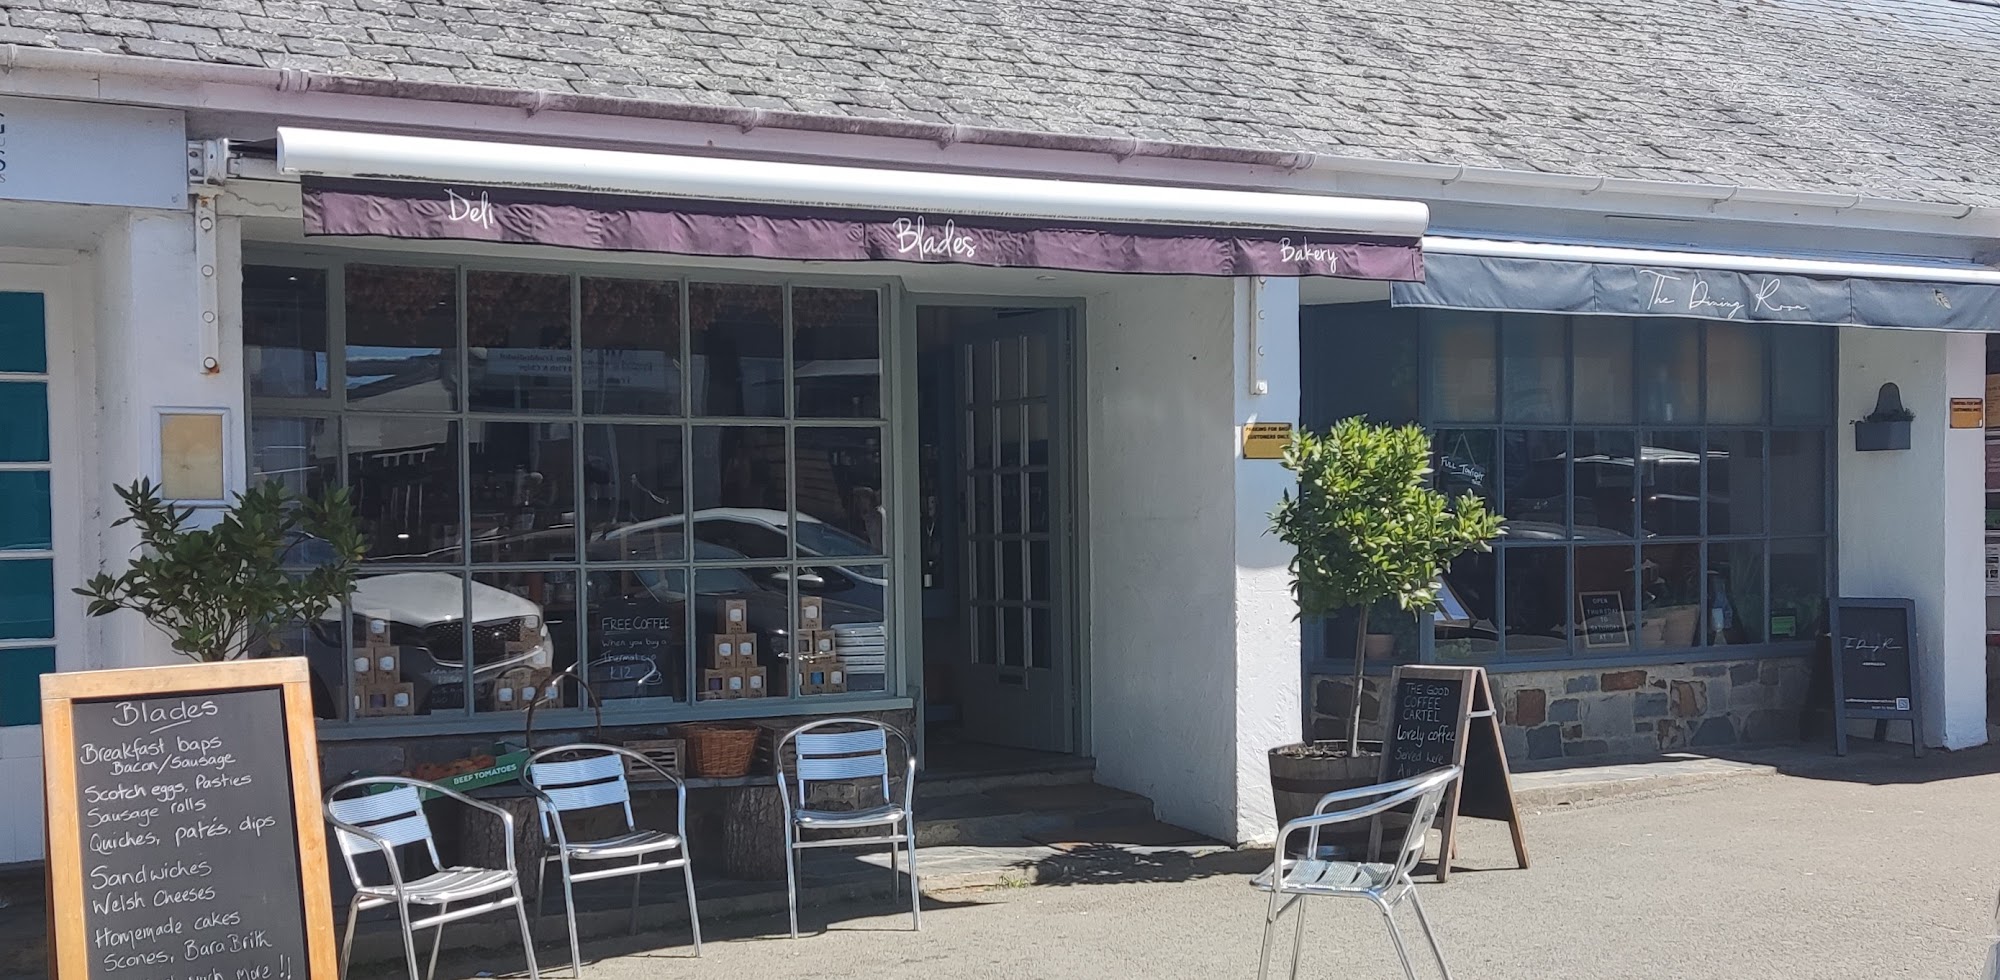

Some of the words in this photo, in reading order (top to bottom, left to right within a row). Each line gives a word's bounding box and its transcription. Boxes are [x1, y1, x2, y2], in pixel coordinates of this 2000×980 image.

[444, 189, 493, 230] Deli
[893, 215, 977, 260] Blades
[1279, 236, 1339, 273] Bakery
[1639, 269, 1681, 310] The
[1689, 278, 1745, 319] Dining
[1441, 456, 1456, 469] FULL
[601, 617, 632, 630] FREE
[633, 616, 671, 630] COFFEE
[629, 640, 643, 648] you
[645, 638, 660, 648] buy
[1404, 695, 1441, 710] COFFEE
[1406, 682, 1423, 695] THE
[1427, 684, 1450, 696] GOOD
[112, 700, 218, 727] Blades
[1402, 709, 1440, 722] CARTEL
[1428, 724, 1455, 744] coffee
[80, 737, 165, 765] Breakfast
[176, 736, 222, 755] baps
[453, 774, 473, 785] BEEF
[474, 763, 517, 779] TOMATOES
[84, 783, 147, 803] Scotch
[195, 773, 252, 790] Pasties
[86, 806, 160, 828] Sausage
[170, 797, 206, 815] rolls
[239, 815, 276, 837] dips
[90, 859, 212, 890] Sandwiches
[92, 891, 146, 915] Welsh
[94, 916, 183, 949] Homemade
[194, 911, 241, 930] cakes
[183, 939, 225, 961] Bara
[227, 929, 273, 953] Brith
